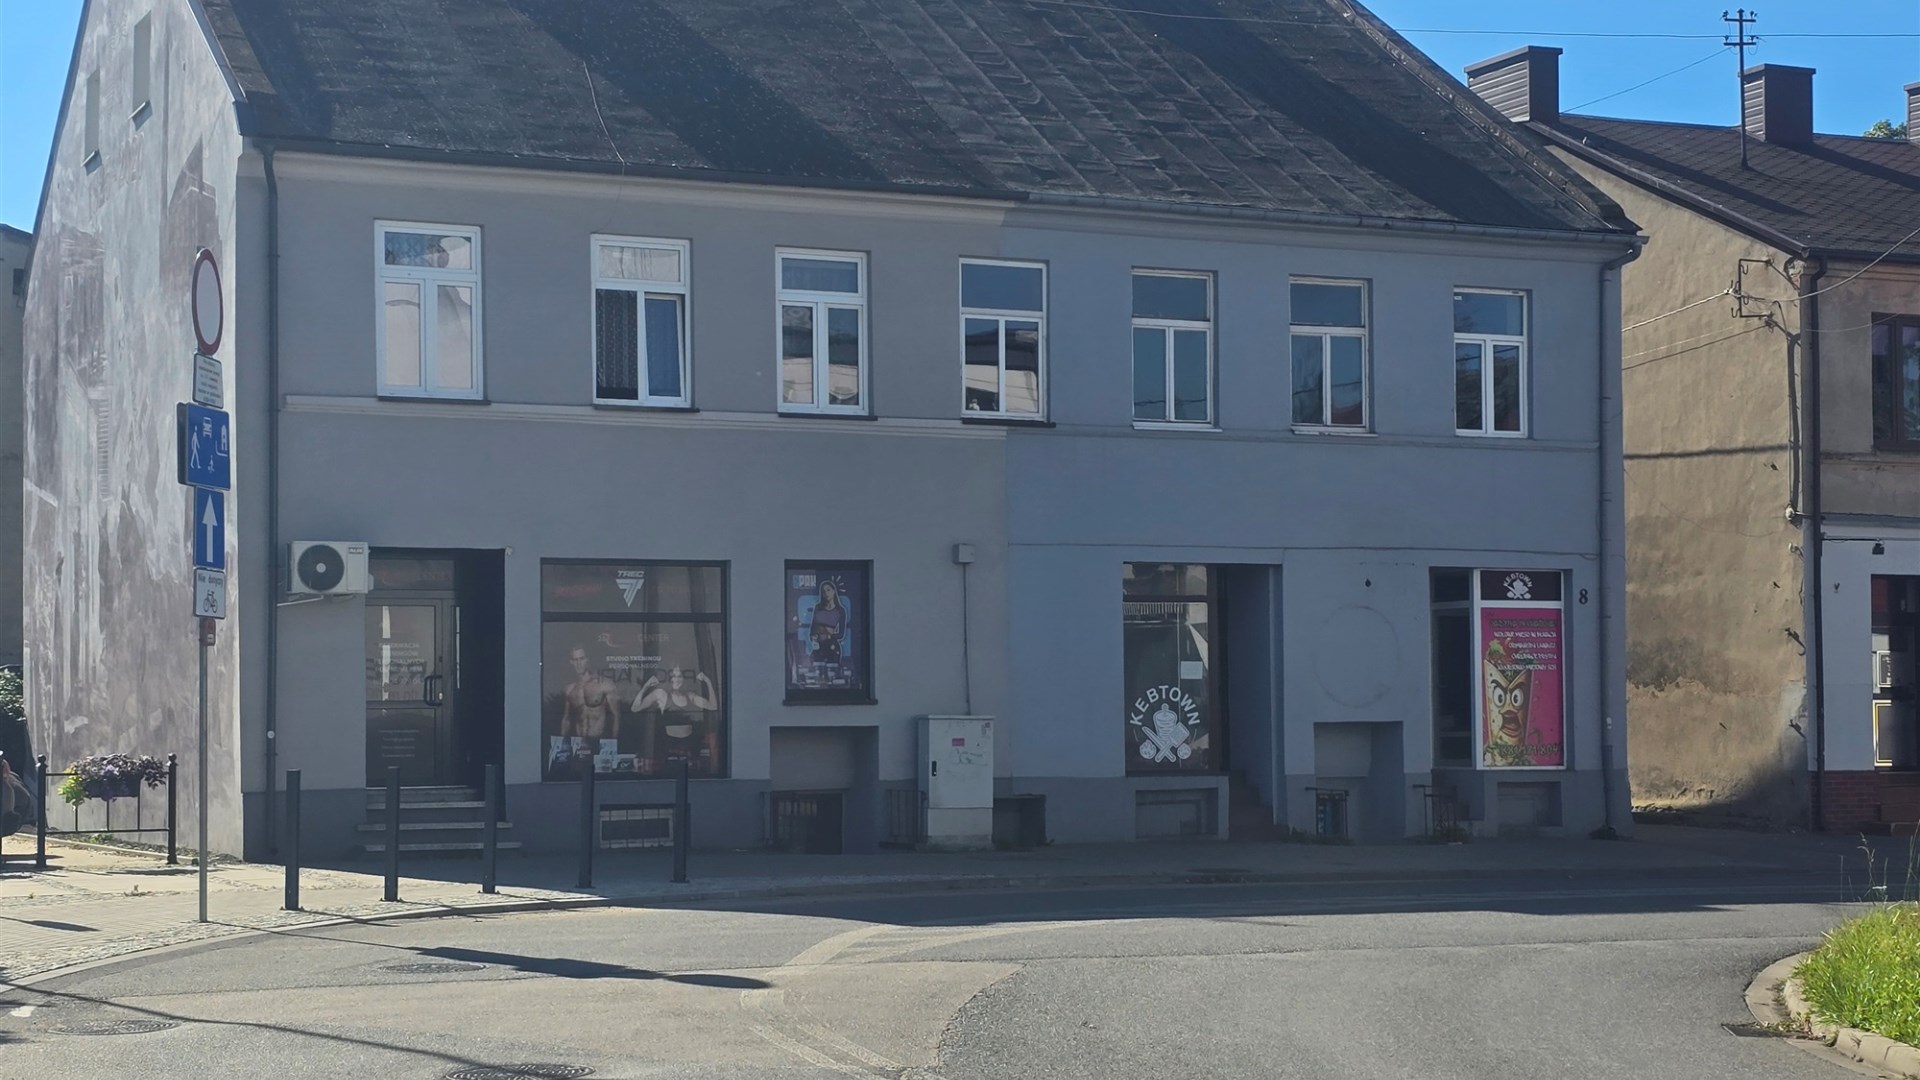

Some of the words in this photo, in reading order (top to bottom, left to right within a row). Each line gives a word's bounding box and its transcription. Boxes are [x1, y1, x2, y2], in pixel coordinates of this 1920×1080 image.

[617, 570, 645, 578] TREC
[1578, 588, 1589, 605] 8
[1129, 685, 1201, 726] KEBTOWN
